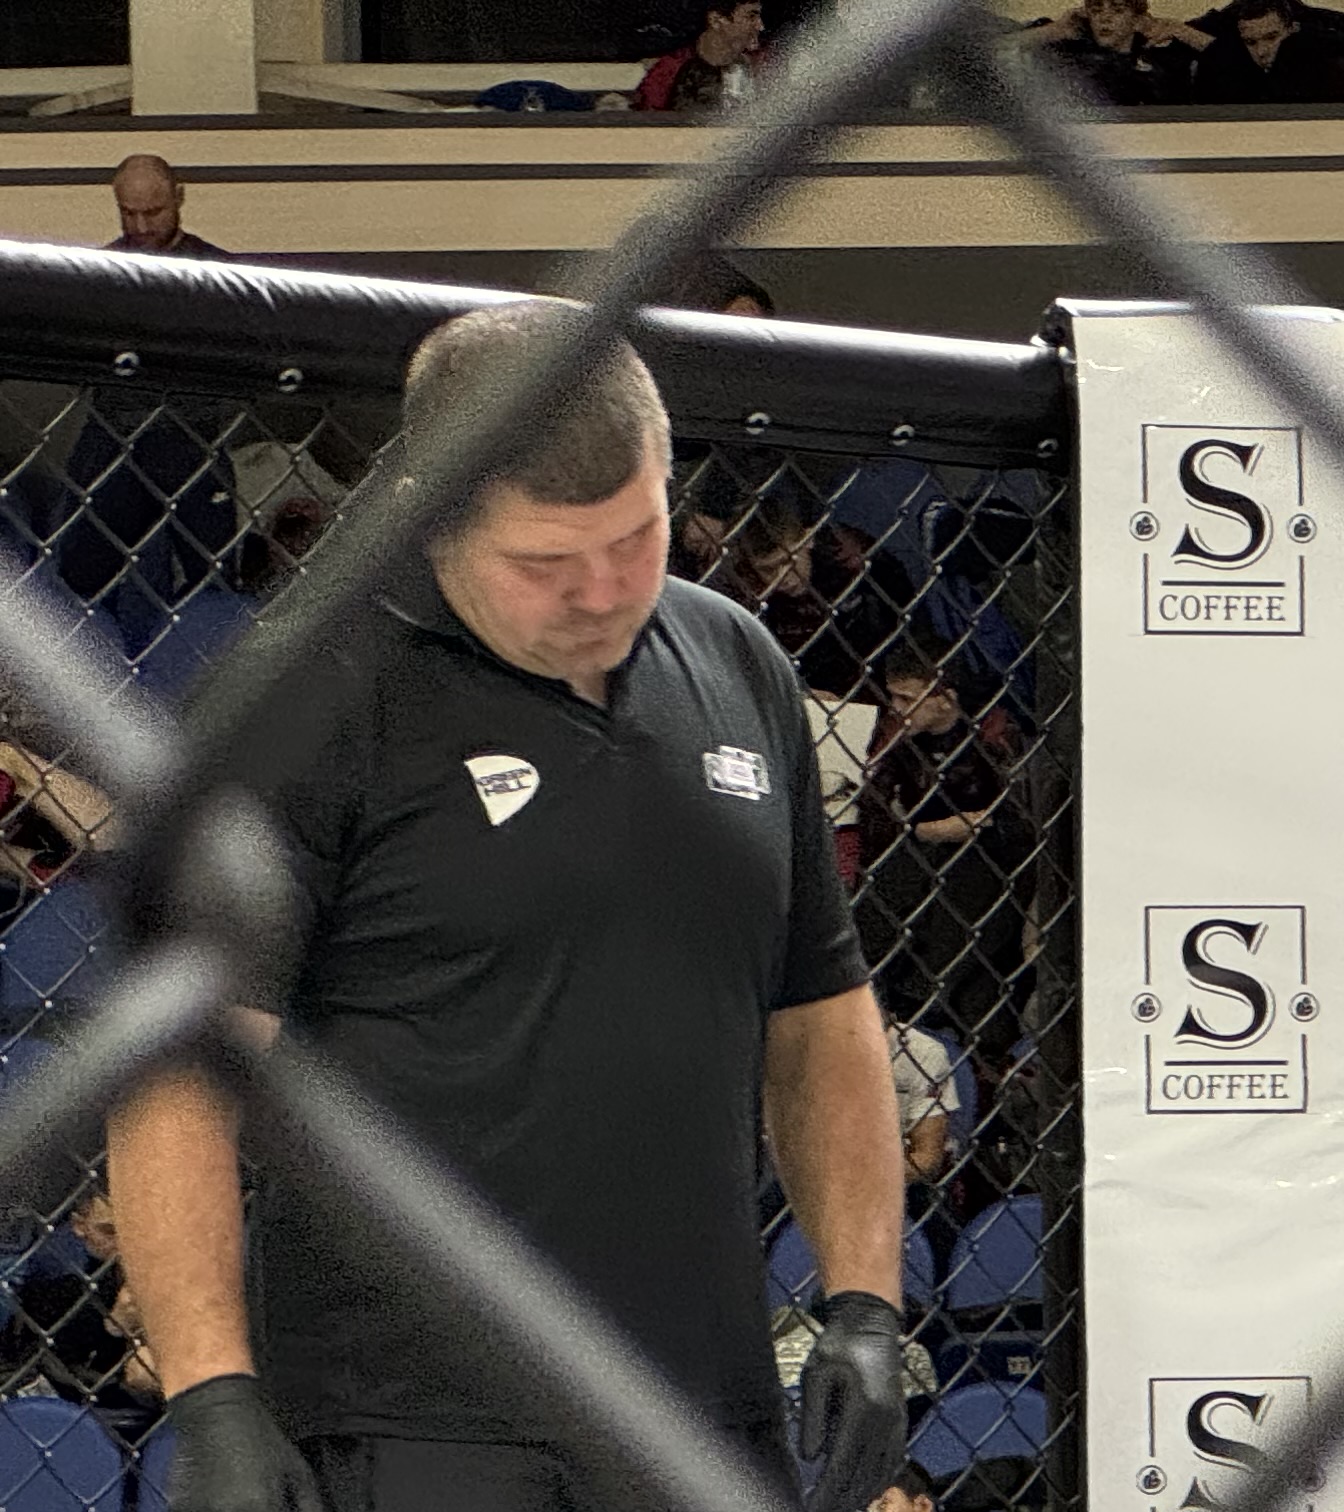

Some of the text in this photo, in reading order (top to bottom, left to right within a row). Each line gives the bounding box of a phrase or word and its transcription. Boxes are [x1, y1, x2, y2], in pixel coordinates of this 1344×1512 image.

[1171, 438, 1274, 571] S
[1159, 594, 1286, 622] COFFEE
[1174, 918, 1277, 1050] S
[1162, 1073, 1290, 1101] COFFEE
